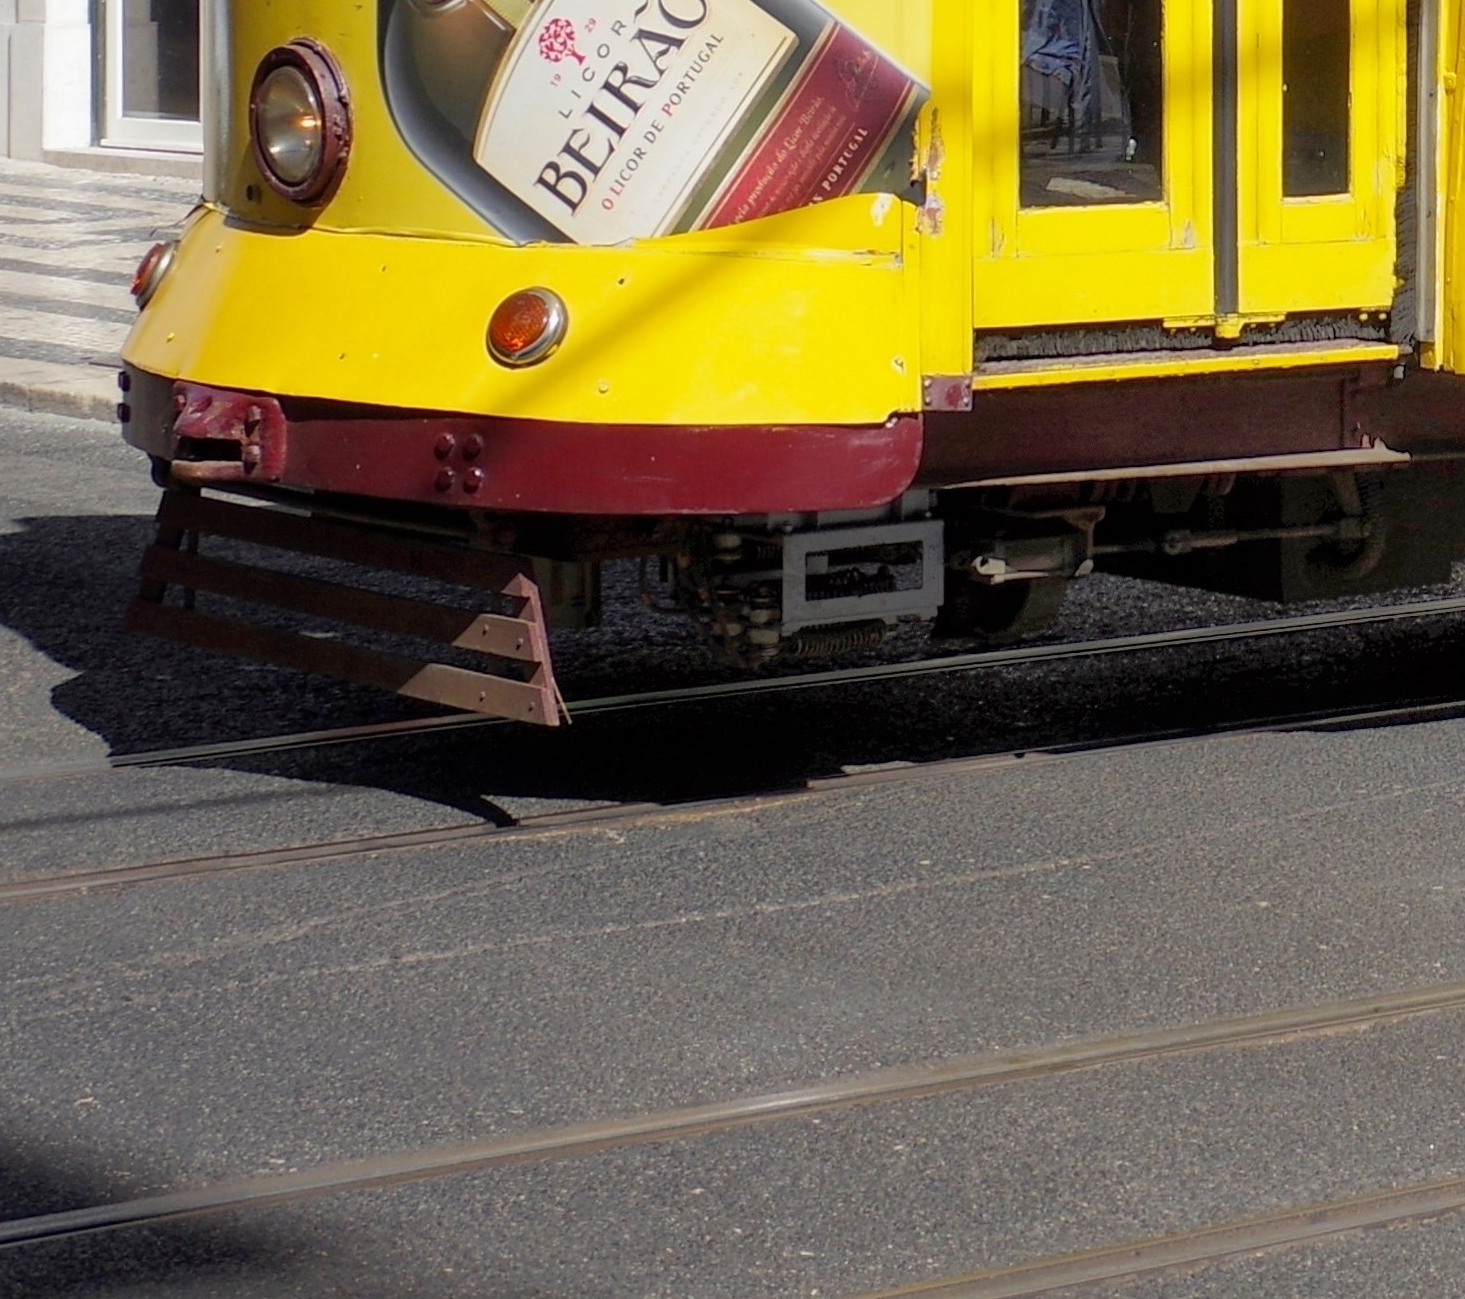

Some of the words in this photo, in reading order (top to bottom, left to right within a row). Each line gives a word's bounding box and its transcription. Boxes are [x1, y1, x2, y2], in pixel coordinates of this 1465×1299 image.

[559, 19, 628, 120] LICOR
[601, 195, 613, 212] O
[609, 148, 648, 195] LICOR
[647, 120, 666, 146] DE
[662, 32, 726, 117] PORTUGAL
[821, 128, 868, 191] PORTUGAL
